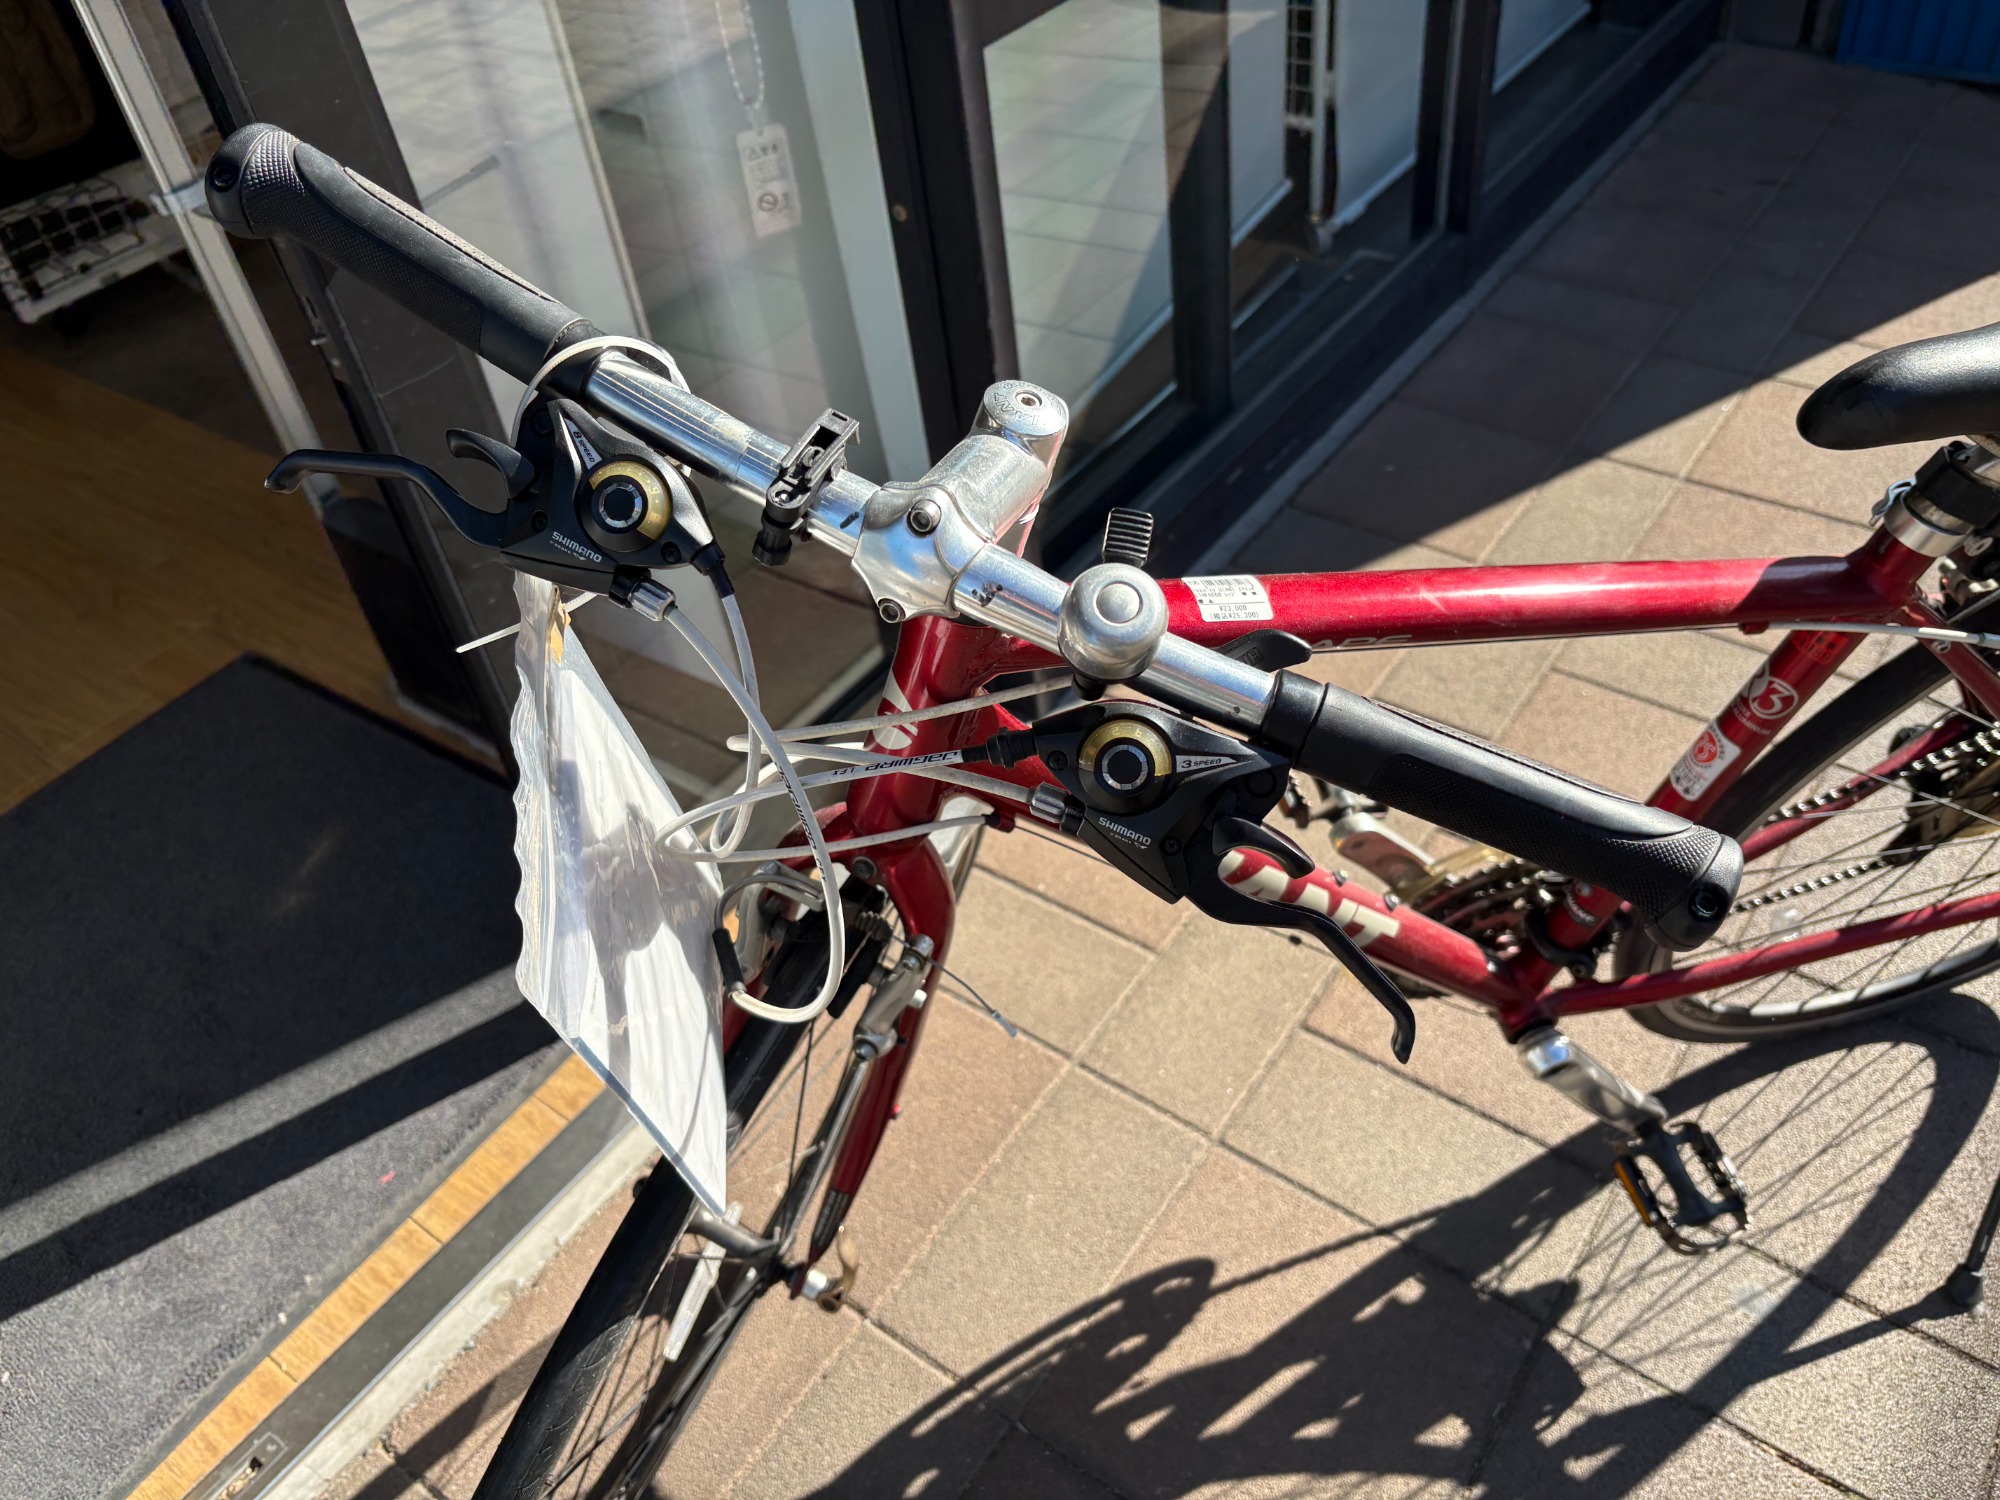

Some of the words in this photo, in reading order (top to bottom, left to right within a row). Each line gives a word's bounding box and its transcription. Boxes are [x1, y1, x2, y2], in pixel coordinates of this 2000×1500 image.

[573, 430, 583, 440] 8
[578, 439, 596, 464] SPEED
[552, 531, 602, 563] SHIMANO
[1181, 759, 1192, 769] 3
[1193, 758, 1222, 767] SPEED
[1099, 817, 1151, 845] SHIMANO
